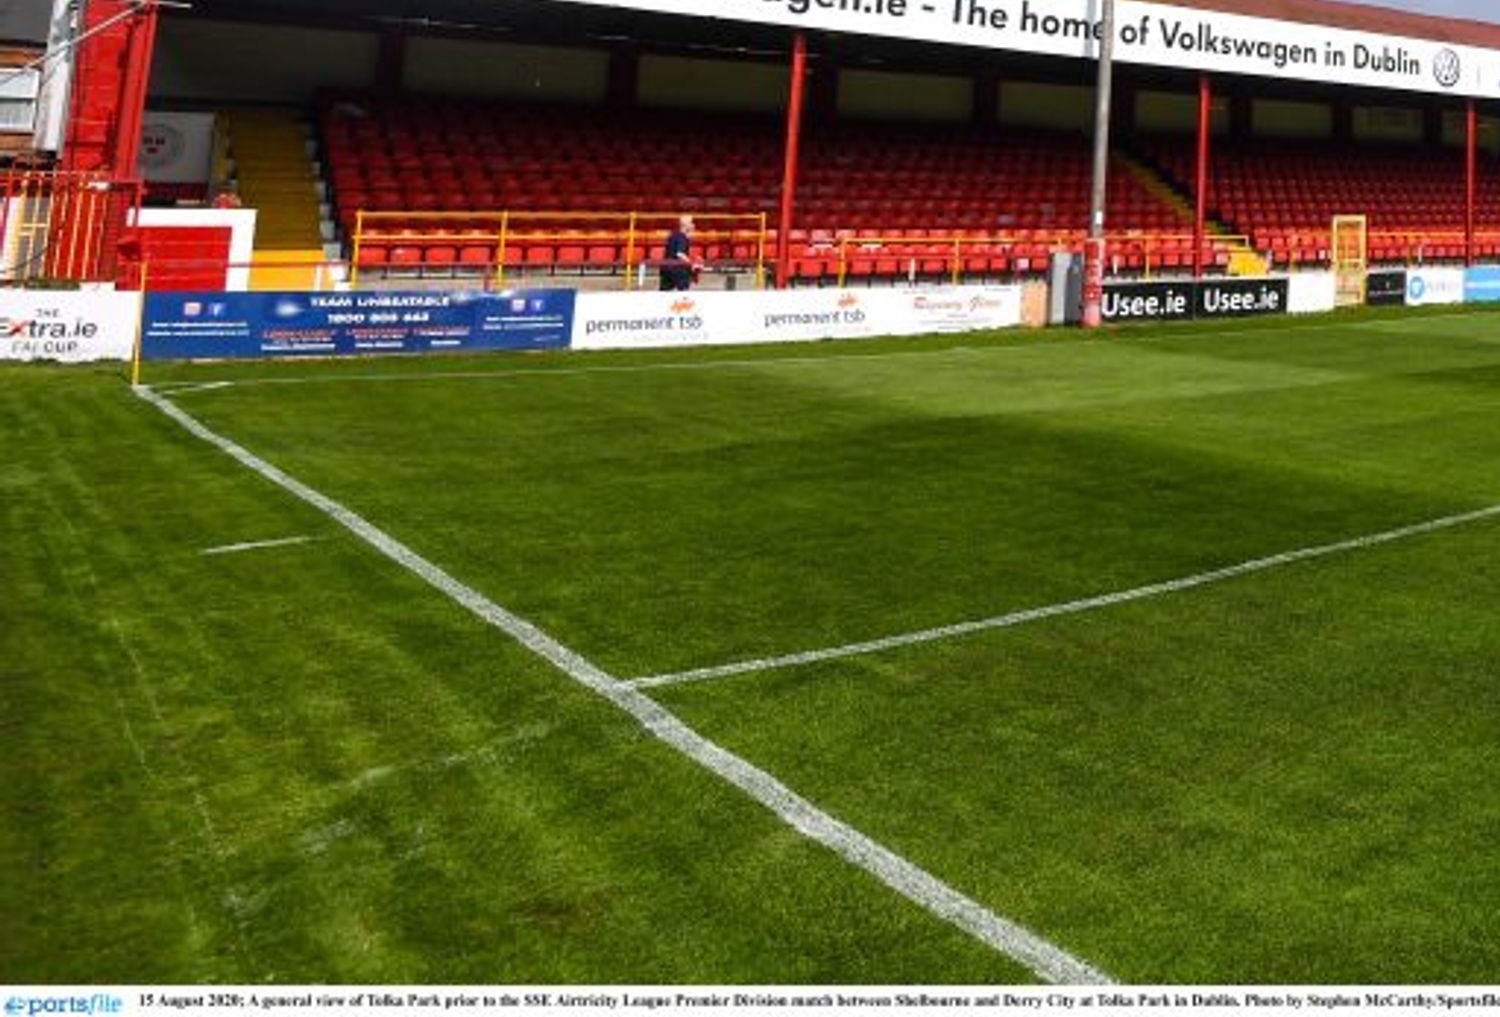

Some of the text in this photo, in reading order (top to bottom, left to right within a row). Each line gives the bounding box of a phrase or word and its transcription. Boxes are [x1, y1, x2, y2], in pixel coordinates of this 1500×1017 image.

[1120, 16, 1149, 45] of
[1160, 18, 1317, 68] Volkswagen
[1324, 42, 1345, 67] in
[1354, 44, 1420, 75] Dublin
[310, 296, 352, 307] TEAM
[1101, 286, 1280, 316] Usee.ie Usee.ie
[586, 315, 702, 334] permanent tsb
[764, 309, 866, 328] permanent tsb
[44, 341, 78, 353] CUP
